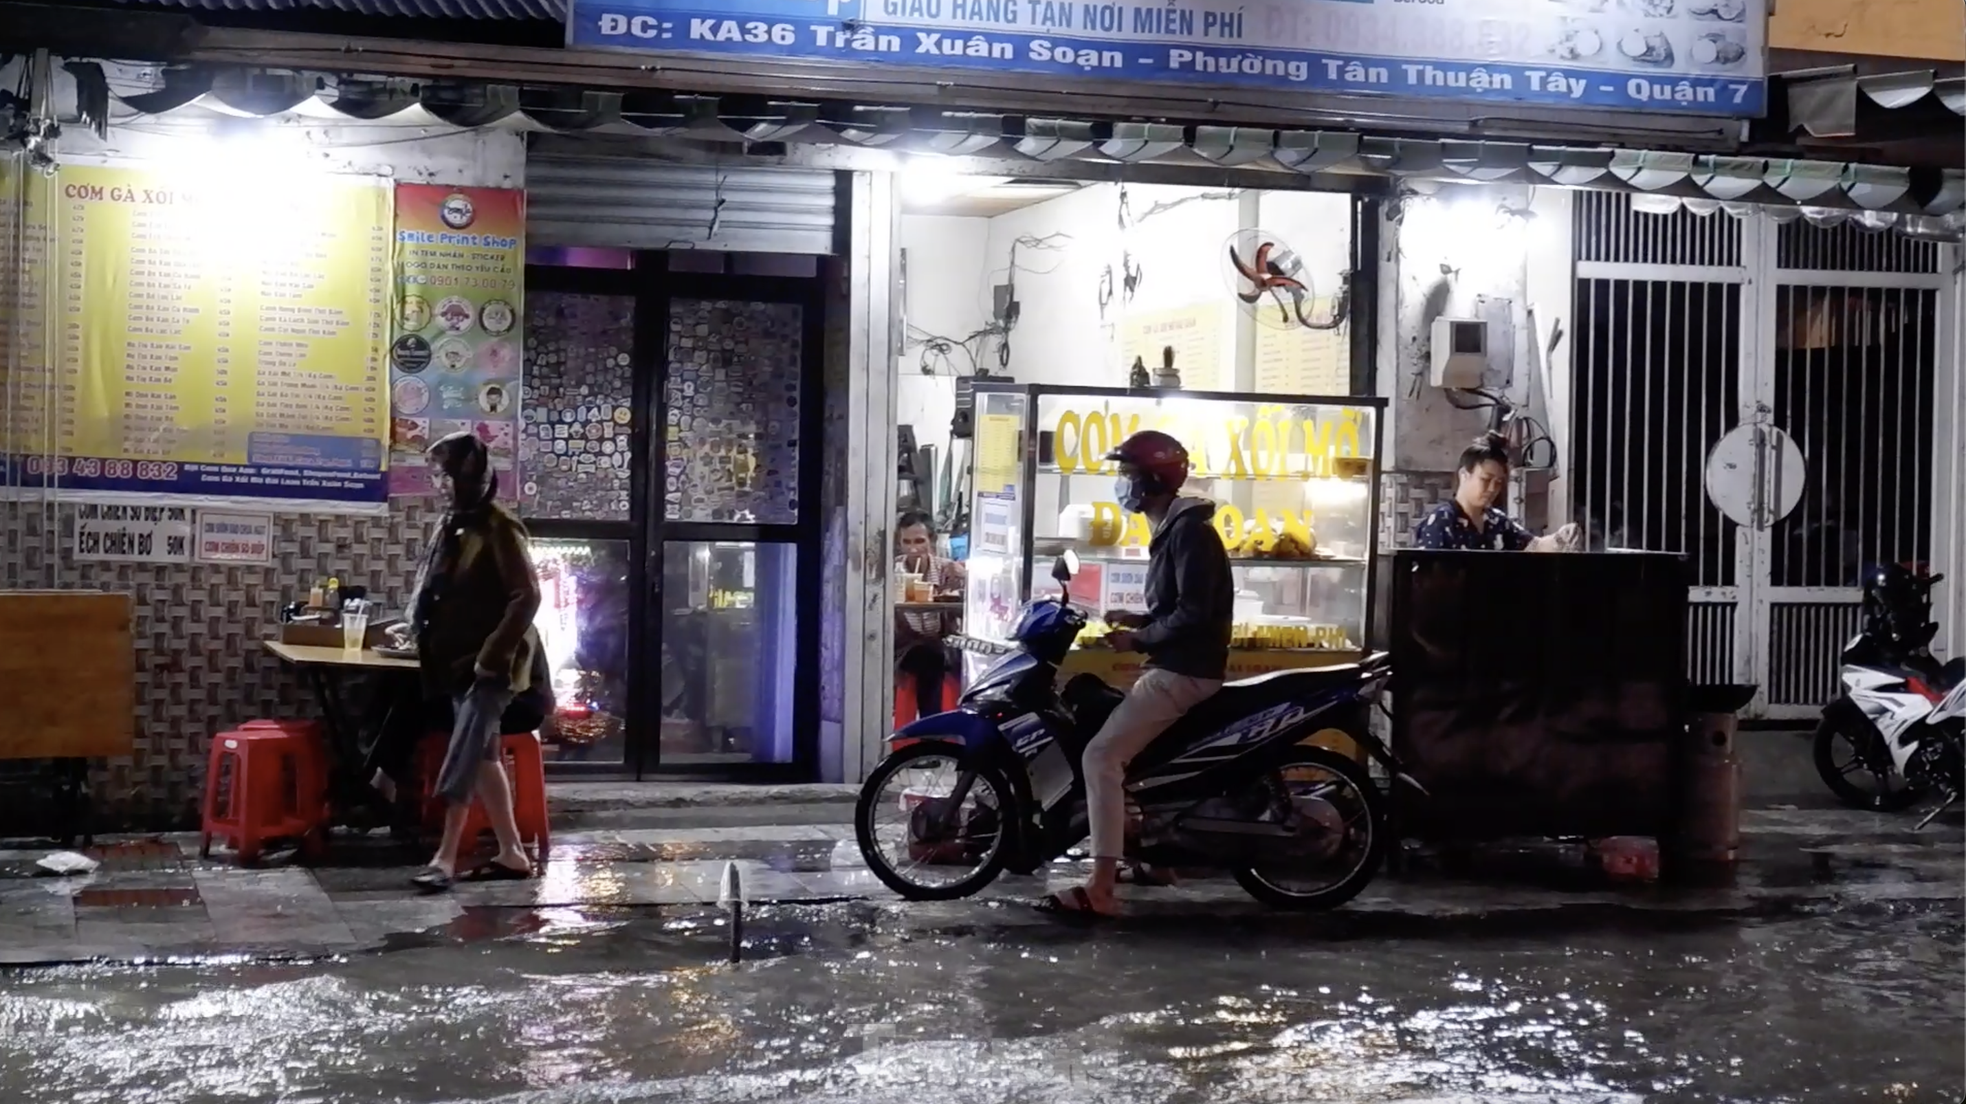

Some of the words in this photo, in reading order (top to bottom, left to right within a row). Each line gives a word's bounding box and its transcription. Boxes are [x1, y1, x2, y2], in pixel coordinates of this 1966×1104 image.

[1084, 3, 1123, 32] NƠI
[1134, 0, 1193, 36] MIỄN
[1204, 7, 1243, 39] PHÍ
[598, 14, 673, 38] ĐC:
[690, 18, 796, 45] KA36
[916, 33, 1014, 60] Xuân
[1029, 40, 1123, 70] Soạn
[1169, 50, 1307, 81] Phường
[1322, 60, 1389, 84] Tân
[1402, 64, 1512, 93] Thuận
[1524, 72, 1588, 98] Tây
[1627, 79, 1717, 106] Quận
[1728, 84, 1748, 104] 7
[65, 183, 104, 201] CƠM
[110, 184, 136, 203] GÀ
[440, 233, 477, 247] Print
[73, 457, 101, 478] 43
[105, 460, 133, 479] 88
[137, 461, 178, 481] 832
[79, 522, 100, 554] ẾCH
[104, 526, 135, 556] CHIÊN
[168, 535, 186, 556] 50K
[1213, 505, 1314, 553] OAN
